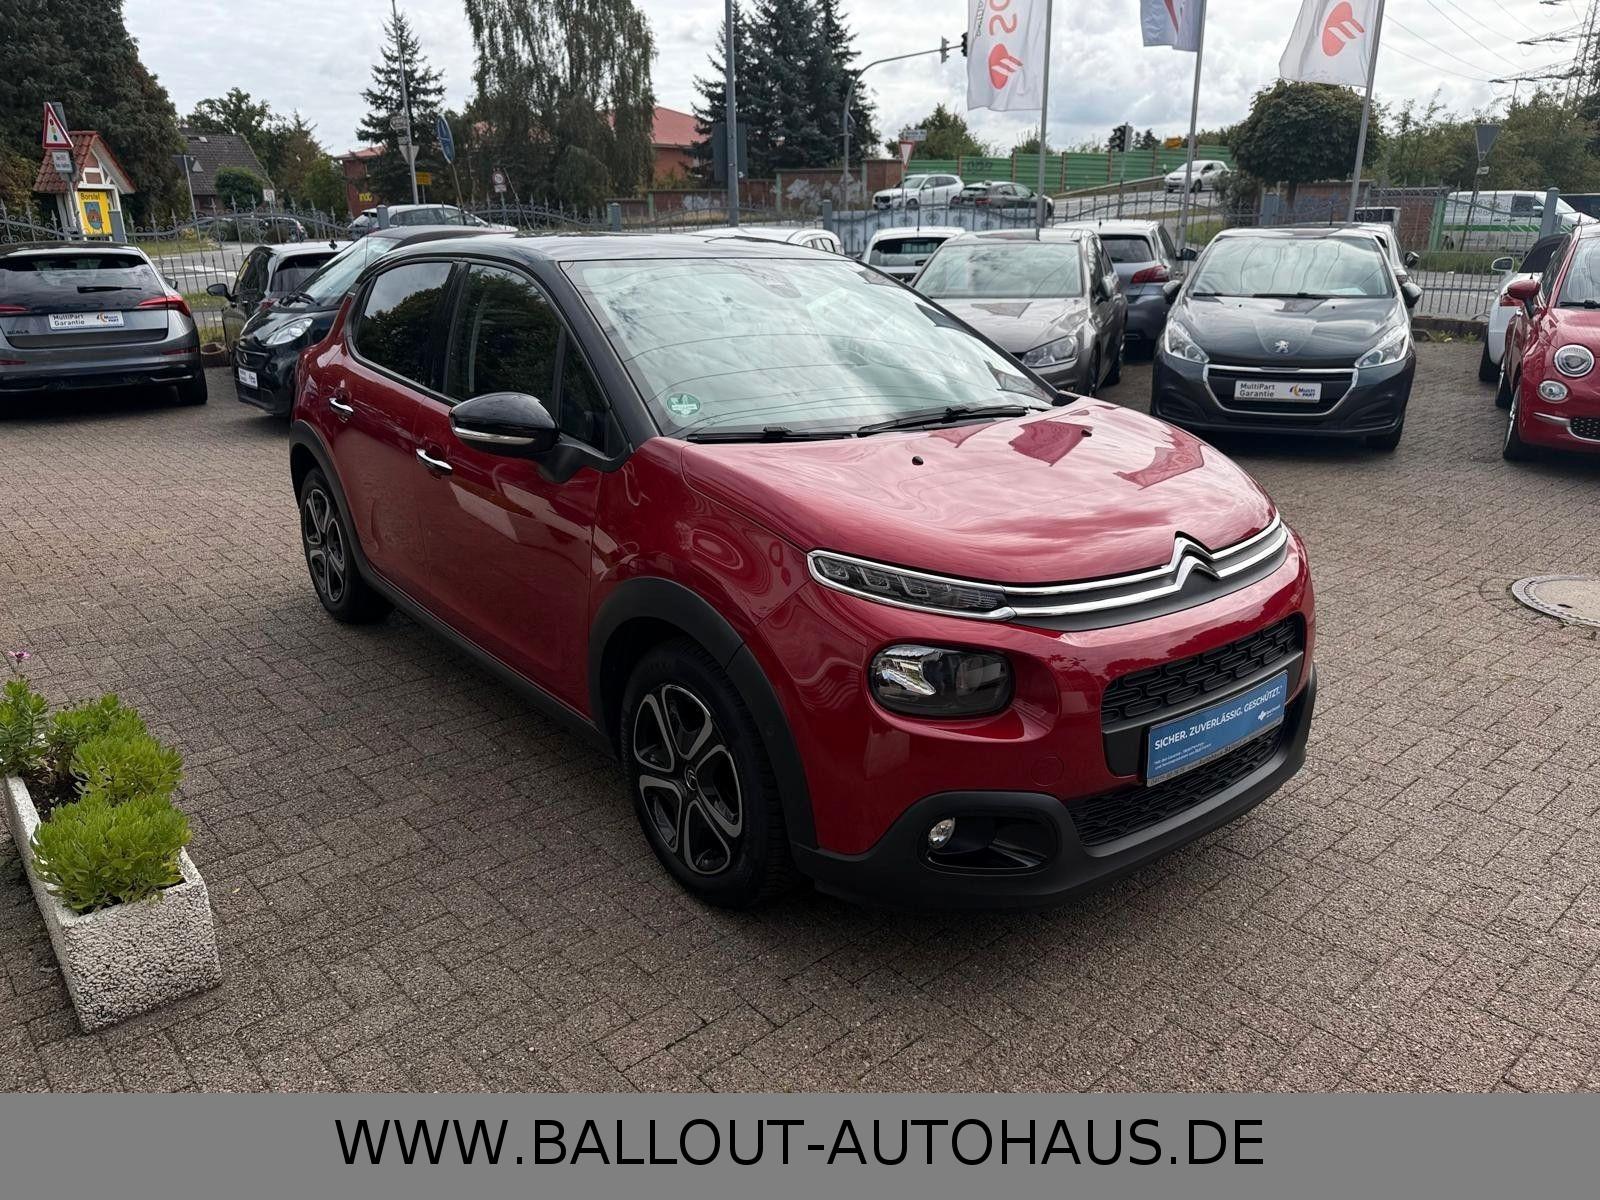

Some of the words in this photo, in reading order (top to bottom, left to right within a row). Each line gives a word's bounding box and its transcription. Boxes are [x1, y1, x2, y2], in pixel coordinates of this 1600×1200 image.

[1240, 390, 1275, 398] Garantie
[1154, 730, 1188, 750] SICHER.
[1189, 706, 1245, 737] ZUVERLÄSSIG.
